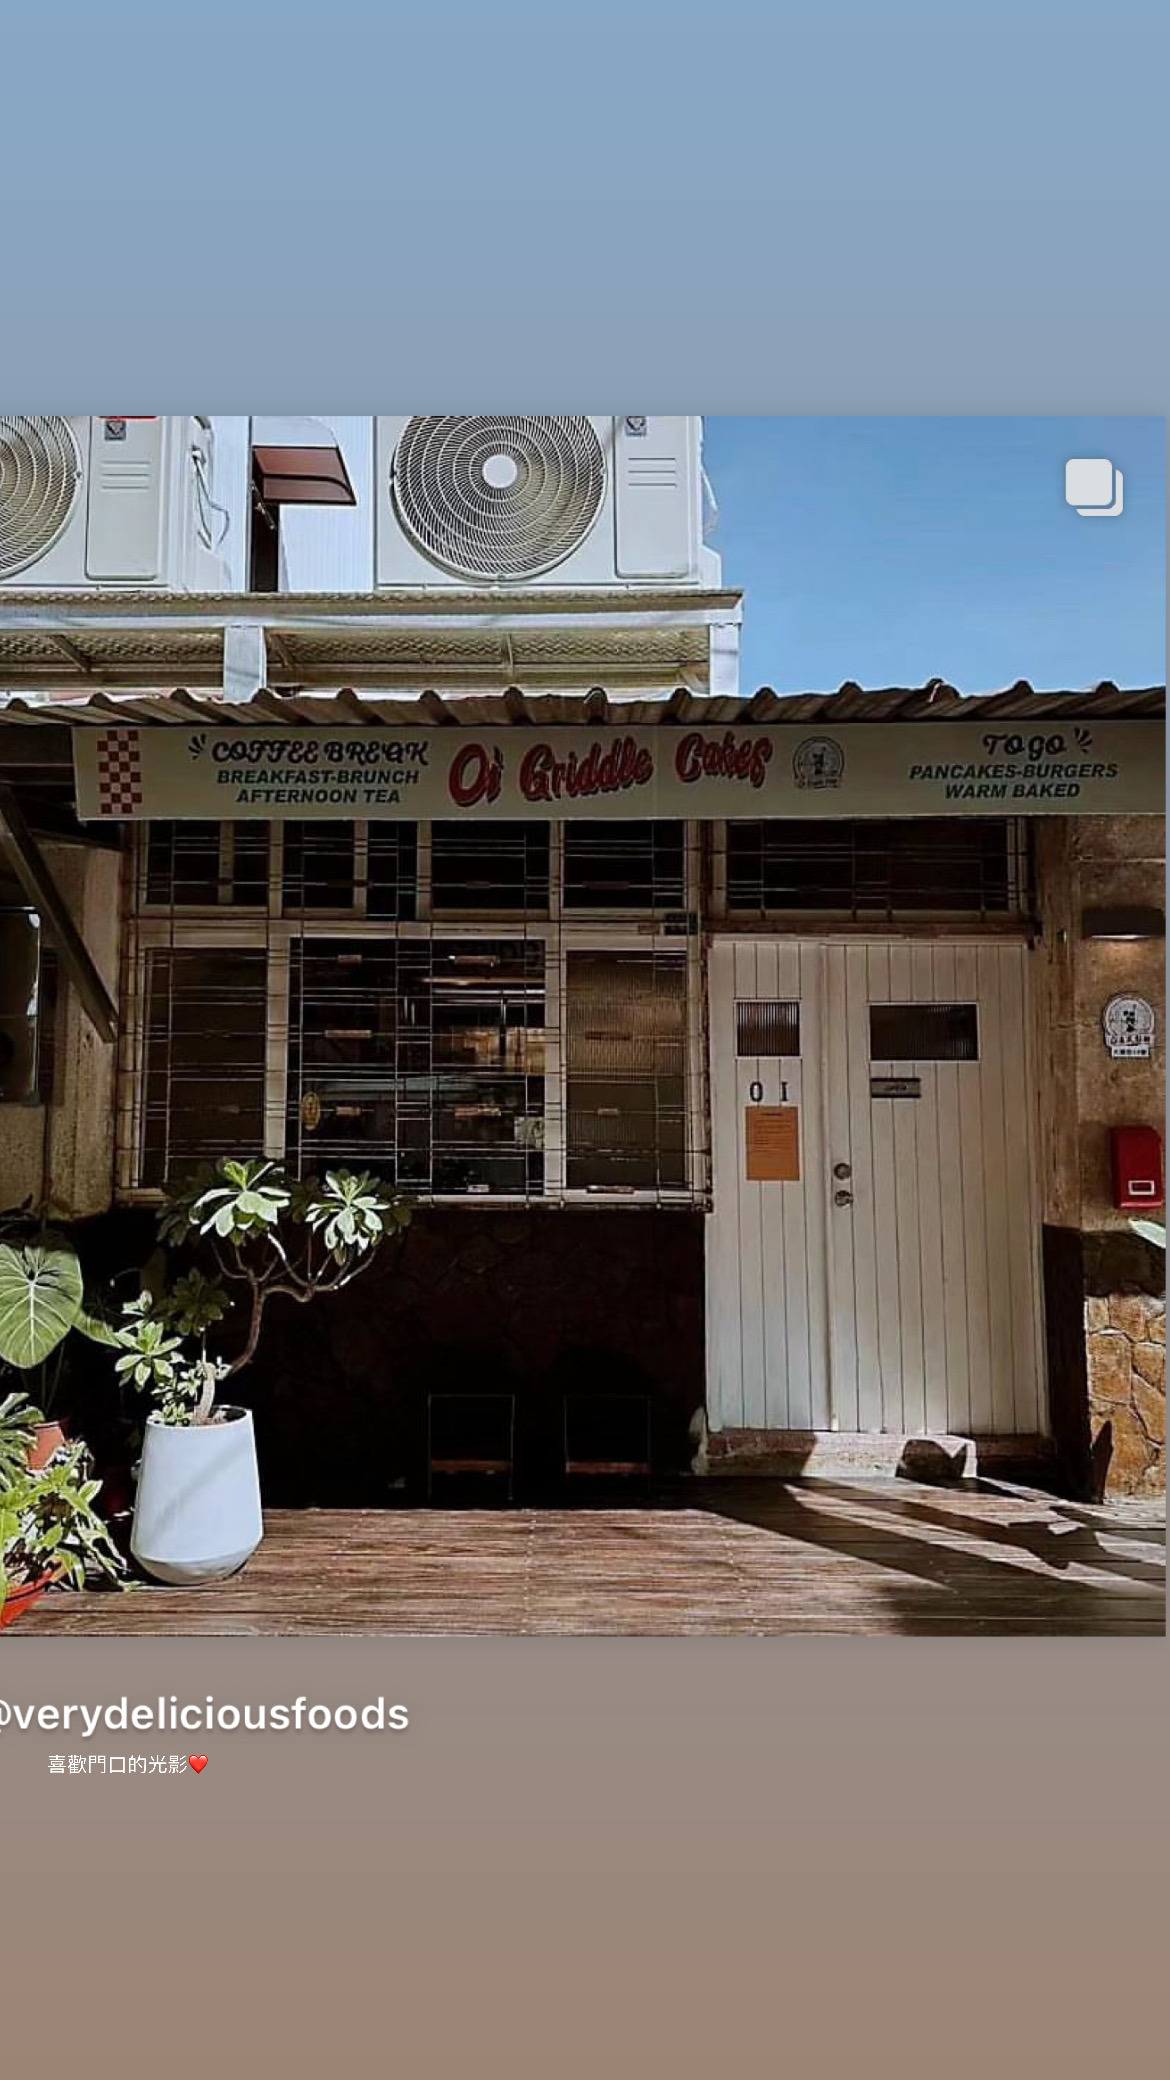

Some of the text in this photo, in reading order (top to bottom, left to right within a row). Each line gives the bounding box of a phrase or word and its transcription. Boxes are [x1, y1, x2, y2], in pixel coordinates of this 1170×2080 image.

[211, 741, 319, 764] COFFEE
[216, 768, 419, 785] BREAKFAST-BRUNCH
[448, 731, 774, 808] Oi Griddle Cakes
[909, 763, 1119, 780] PANCAKES-BURGERS
[235, 789, 401, 804] AFTERNOON TEA
[945, 783, 1081, 799] WARM BAKED
